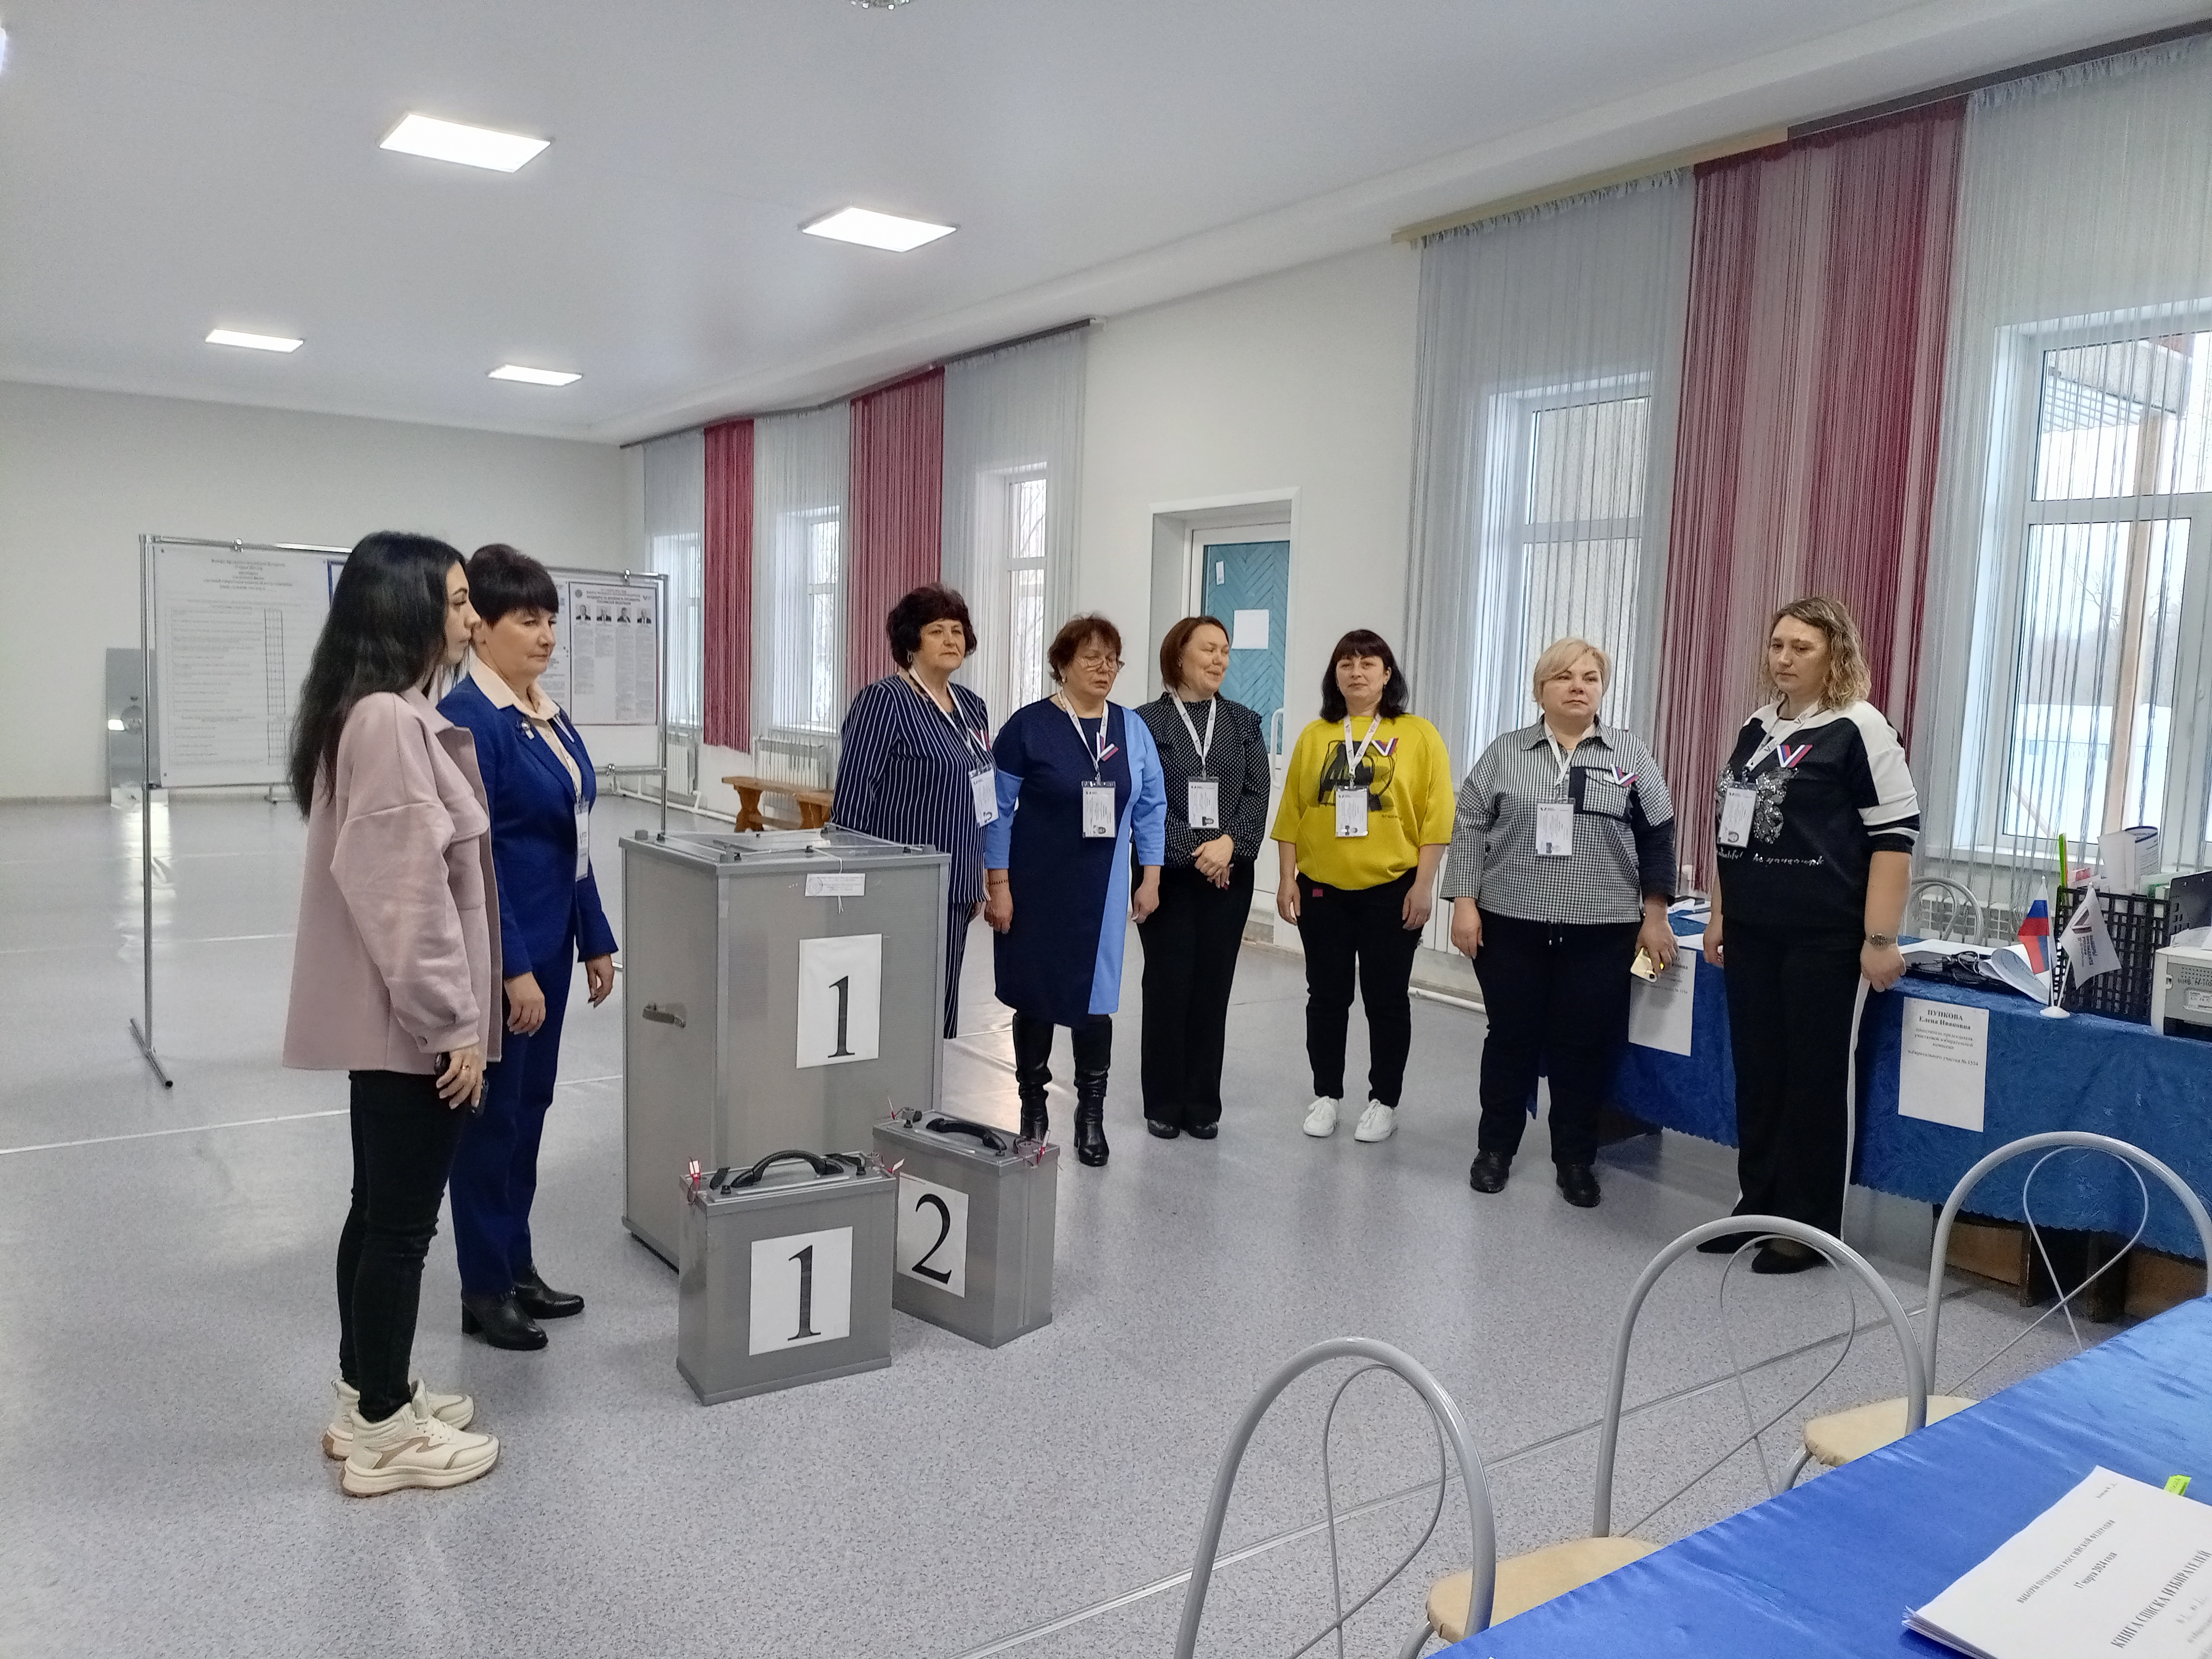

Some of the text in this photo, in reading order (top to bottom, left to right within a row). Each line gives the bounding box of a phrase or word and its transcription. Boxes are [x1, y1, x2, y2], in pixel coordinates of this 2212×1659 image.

[828, 975, 855, 1058] 1
[1919, 1016, 1971, 1030] Елена Ивановна
[911, 1193, 952, 1285] 2
[788, 1245, 821, 1341] 1
[2017, 1519, 2116, 1604] ВЫБОРЫ ПРЕЗИДЕНТА РОССИЙСКОЙ ФЕДЕРАЦИИ
[2081, 1572, 2098, 1584] марта
[2092, 1561, 2108, 1573] 2024
[2104, 1552, 2118, 1565] года
[2111, 1622, 2144, 1648] КНИГА
[2136, 1596, 2171, 1623] СПИСКА
[2161, 1549, 2212, 1597] ИЗБИРАТЕЛЕЙ
